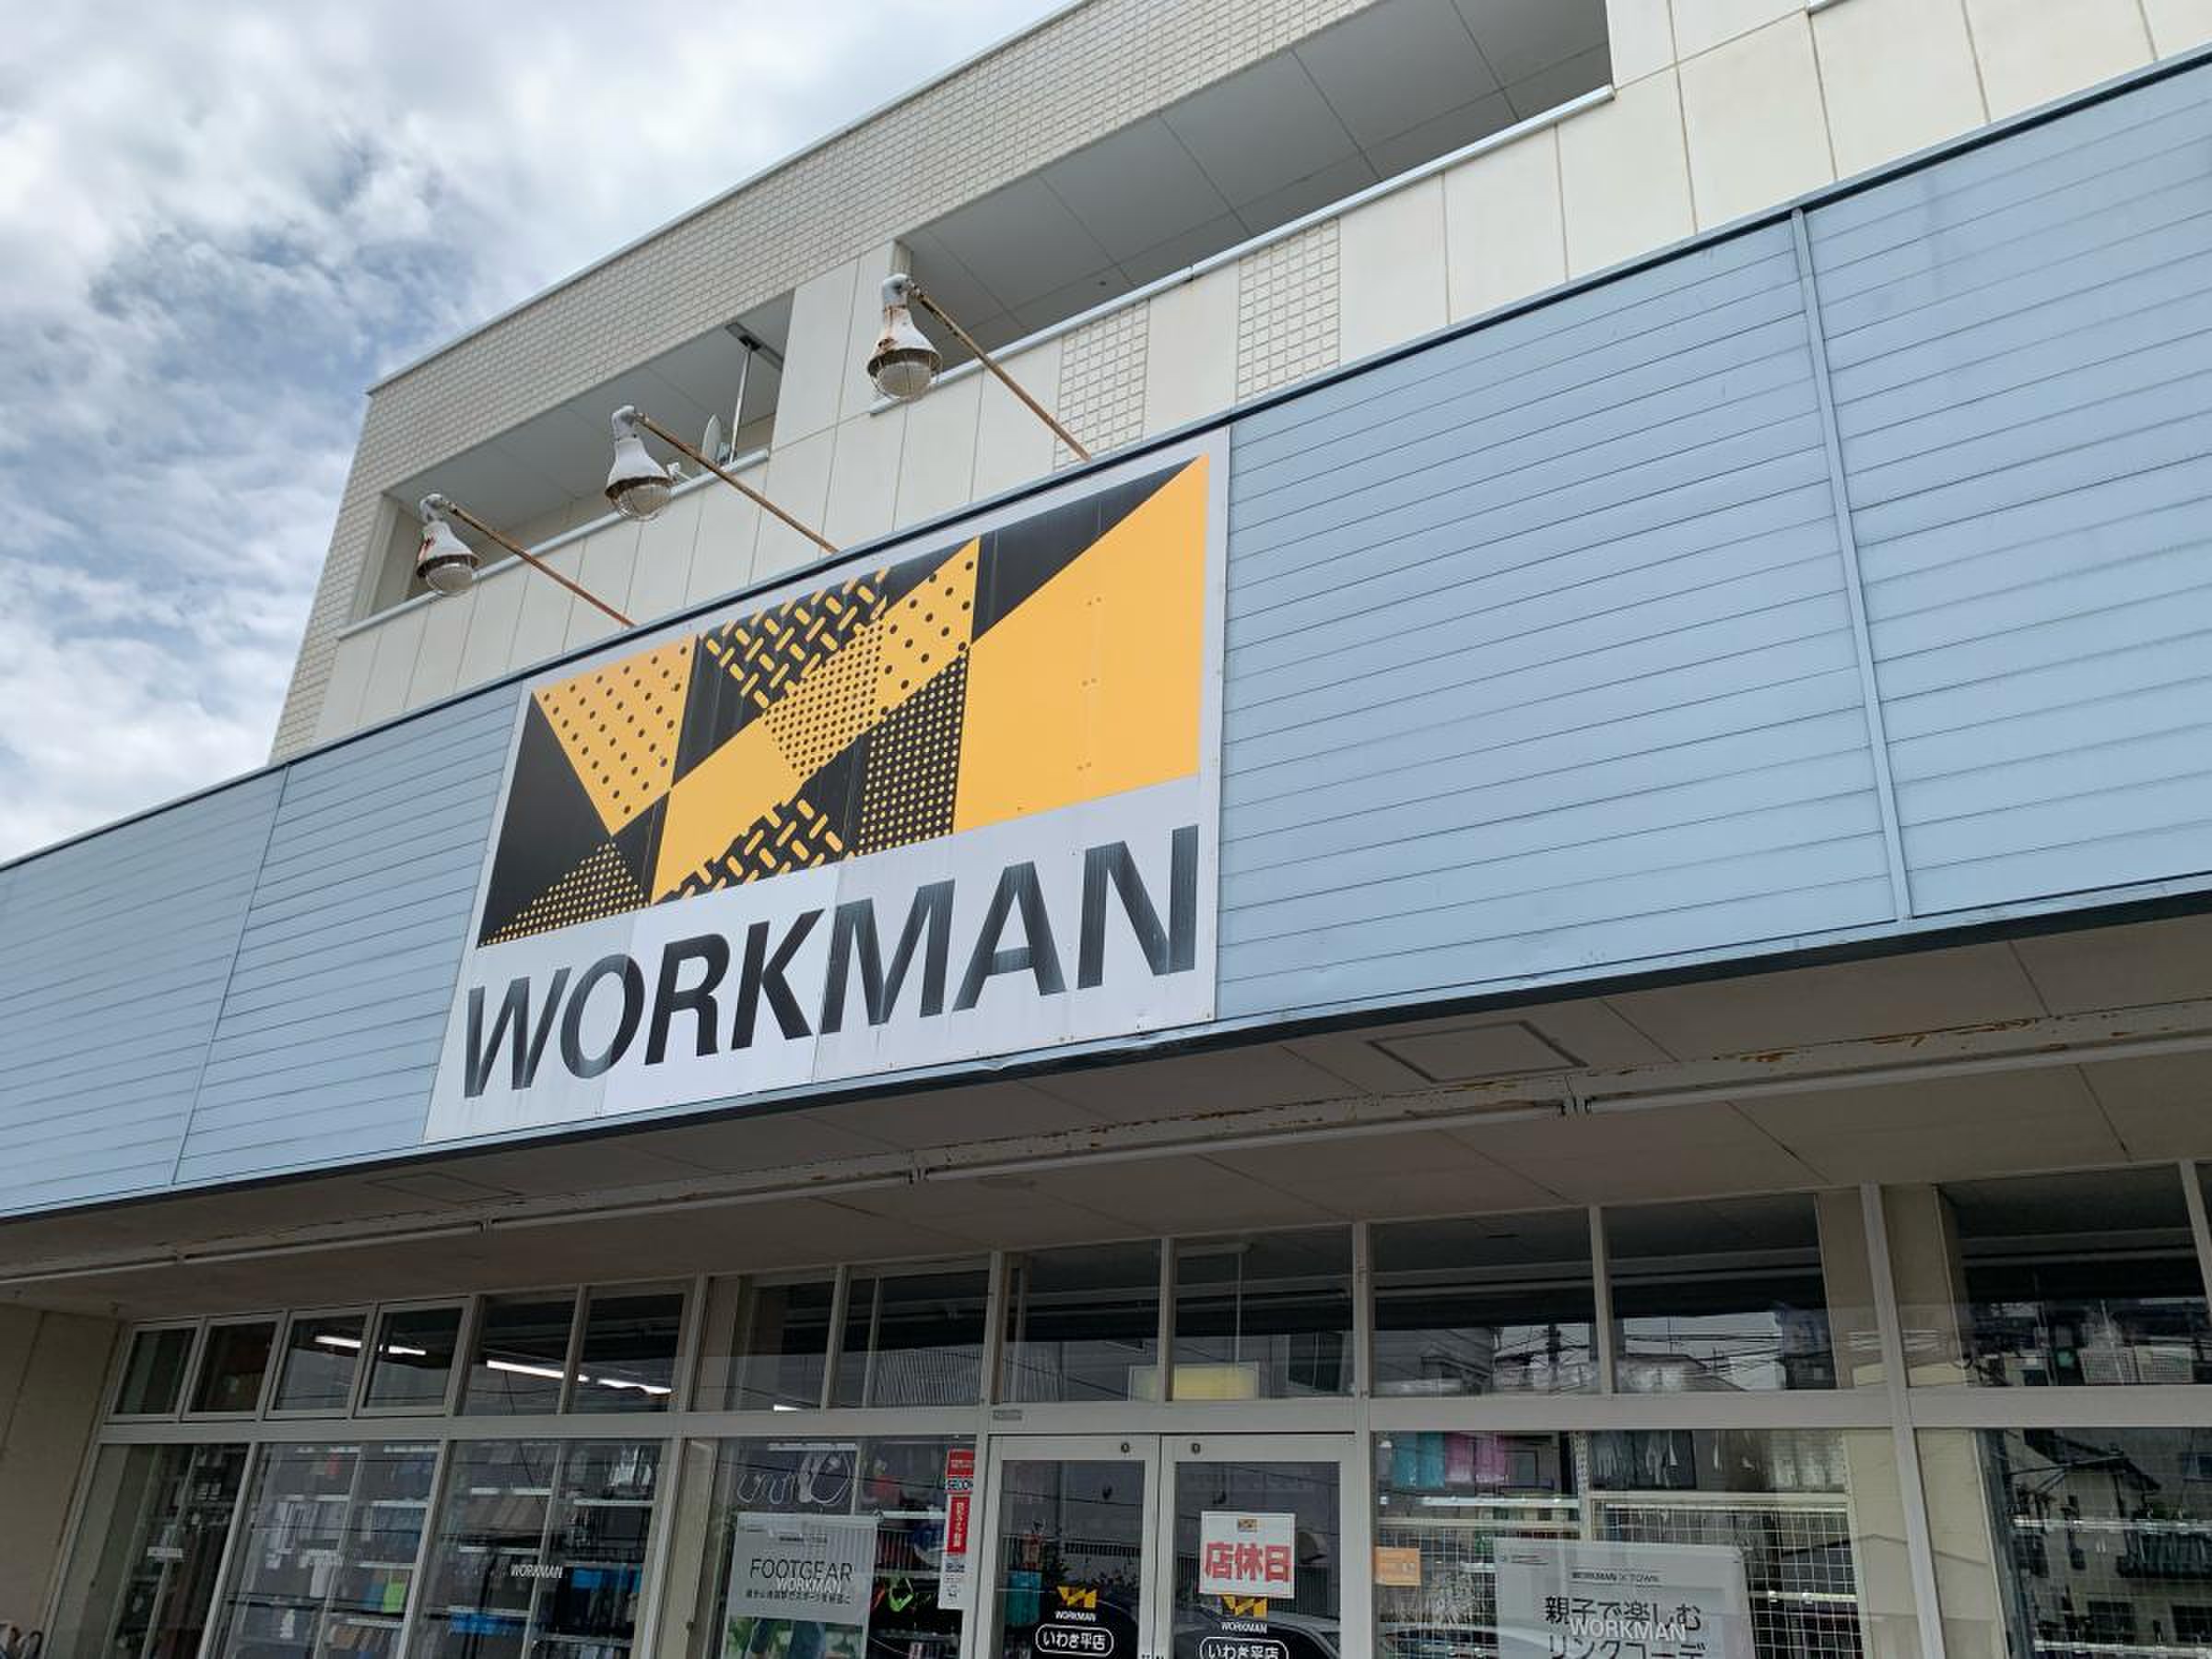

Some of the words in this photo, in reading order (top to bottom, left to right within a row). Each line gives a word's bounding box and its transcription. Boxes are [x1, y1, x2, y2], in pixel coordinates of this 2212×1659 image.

[465, 825, 1200, 1099] WORKMAN
[512, 1563, 563, 1578] WORKMAN
[750, 1559, 853, 1582] FOOTGEAR
[1205, 1542, 1289, 1582] 店休日
[1054, 1609, 1097, 1622] WORKMAN
[1545, 1595, 1701, 1632] 親子で楽しむ
[1221, 1621, 1268, 1634] WORKMAN
[1570, 1617, 1686, 1642] WORKMAN
[1043, 1630, 1107, 1651] いわき平店
